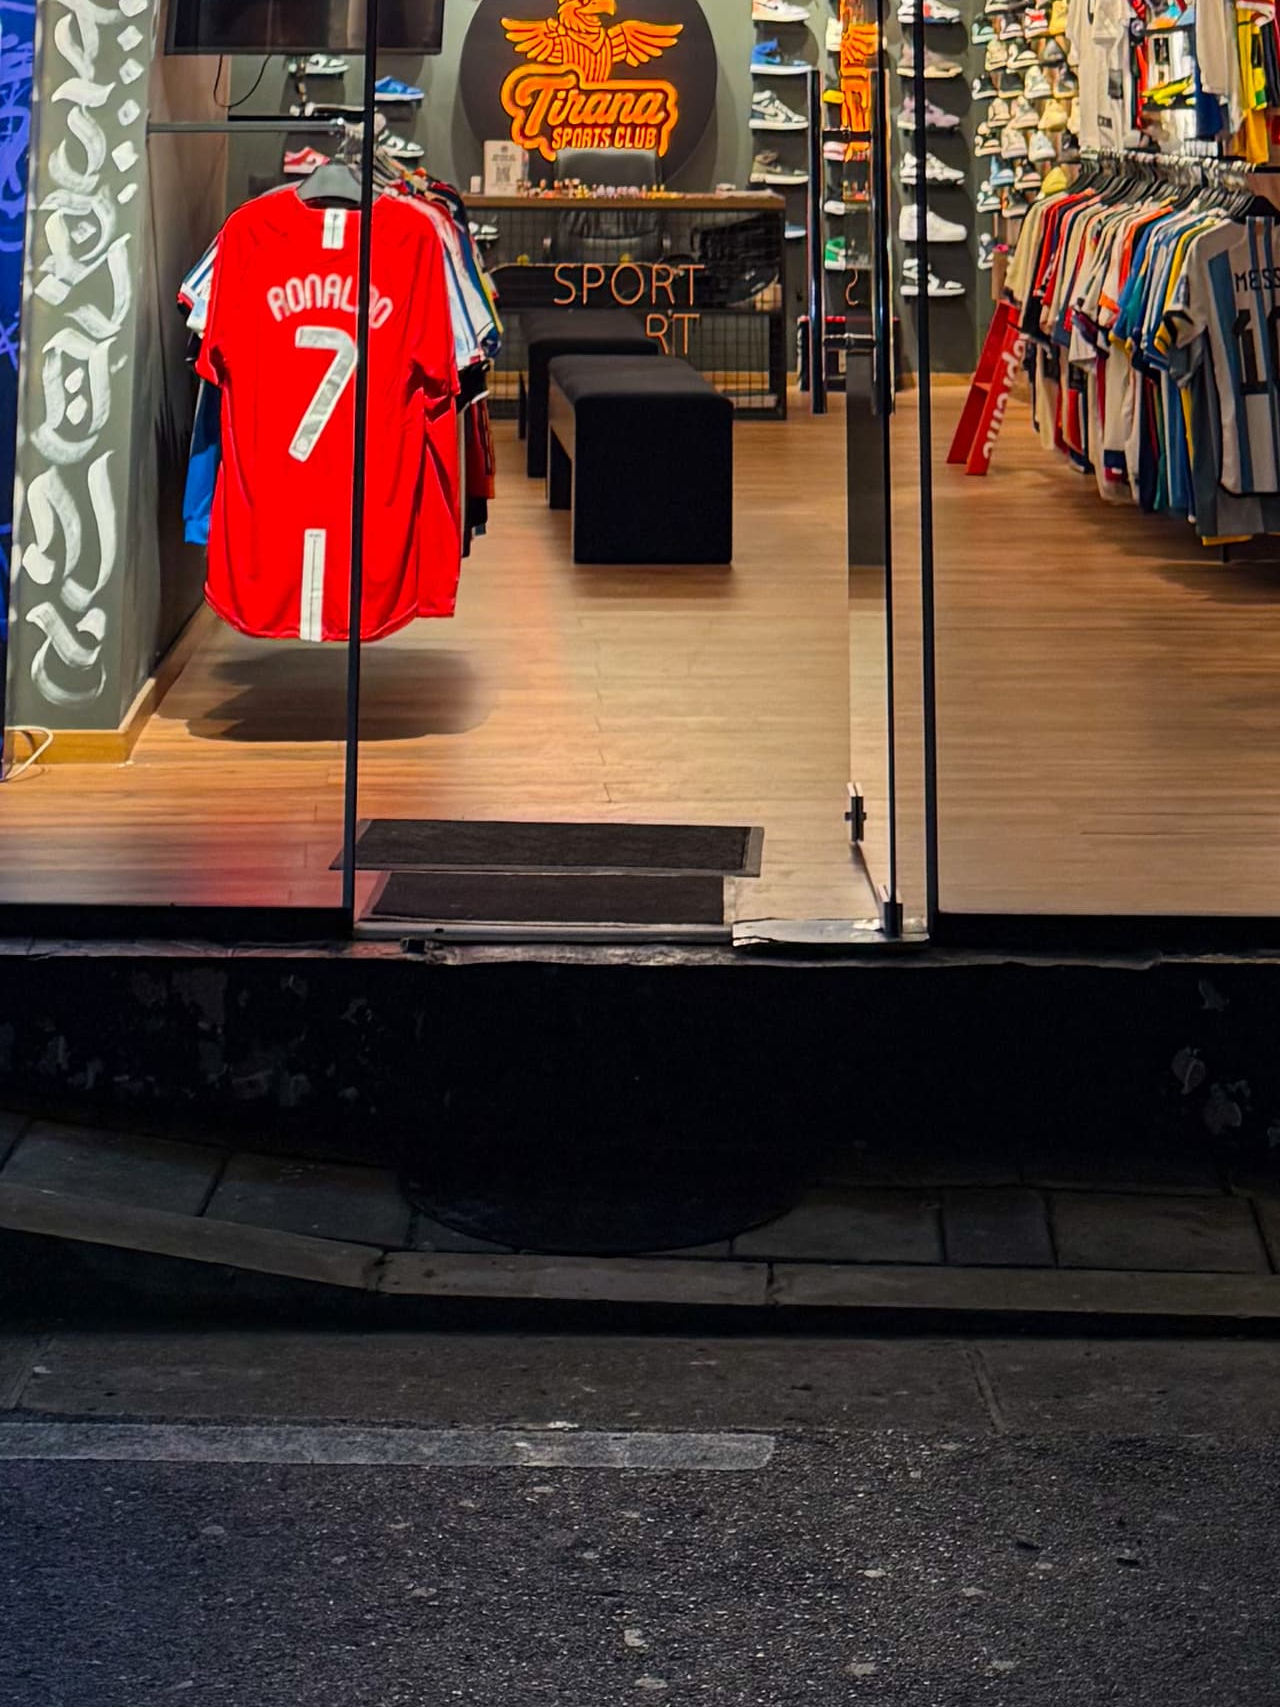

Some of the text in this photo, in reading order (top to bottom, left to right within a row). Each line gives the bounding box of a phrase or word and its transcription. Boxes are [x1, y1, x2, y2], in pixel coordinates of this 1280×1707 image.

[515, 77, 668, 137] Tirana
[551, 127, 658, 150] SPORTS CLUB
[552, 262, 705, 306] SPORT
[288, 325, 359, 463] 7
[982, 333, 1027, 460] upreme
